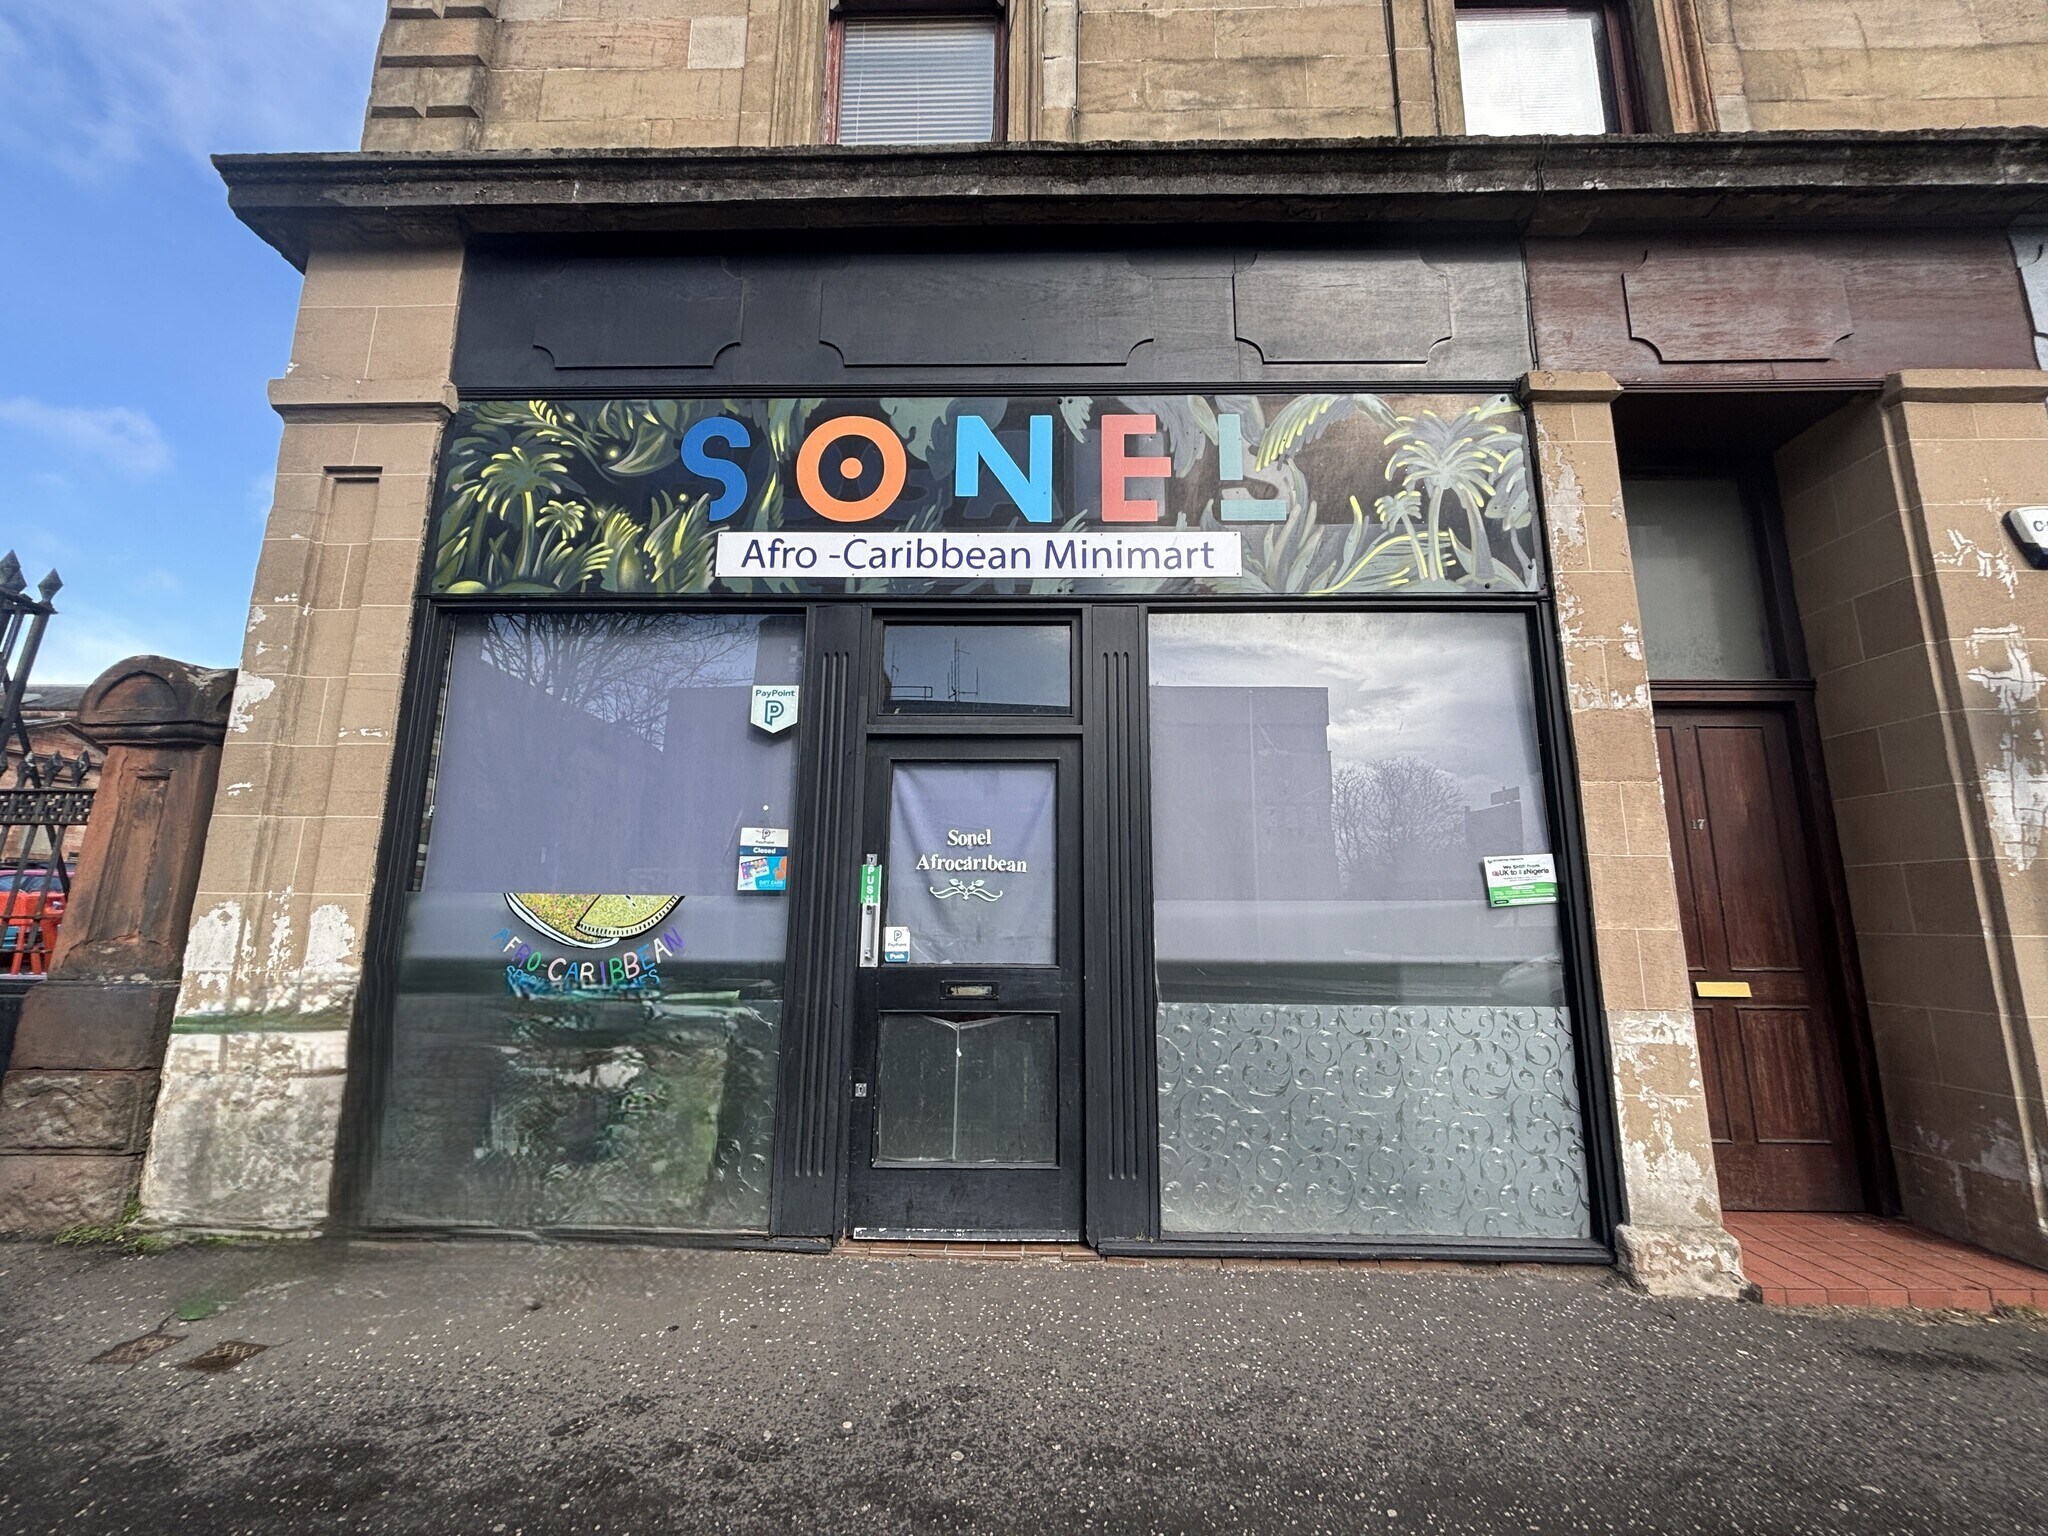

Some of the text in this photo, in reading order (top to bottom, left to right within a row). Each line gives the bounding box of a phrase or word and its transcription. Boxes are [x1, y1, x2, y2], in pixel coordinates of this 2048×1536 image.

[680, 413, 1287, 523] SONEL
[741, 538, 818, 570] Afro
[1044, 539, 1215, 570] Minimart
[755, 689, 795, 698] PayPoint
[1690, 818, 1706, 830] 17
[946, 828, 992, 846] Sonel
[916, 854, 1027, 872] Afrocaribean
[866, 866, 876, 906] PUSH
[491, 926, 685, 986] AFRO-CARIBBEAN
[889, 952, 905, 960] Push
